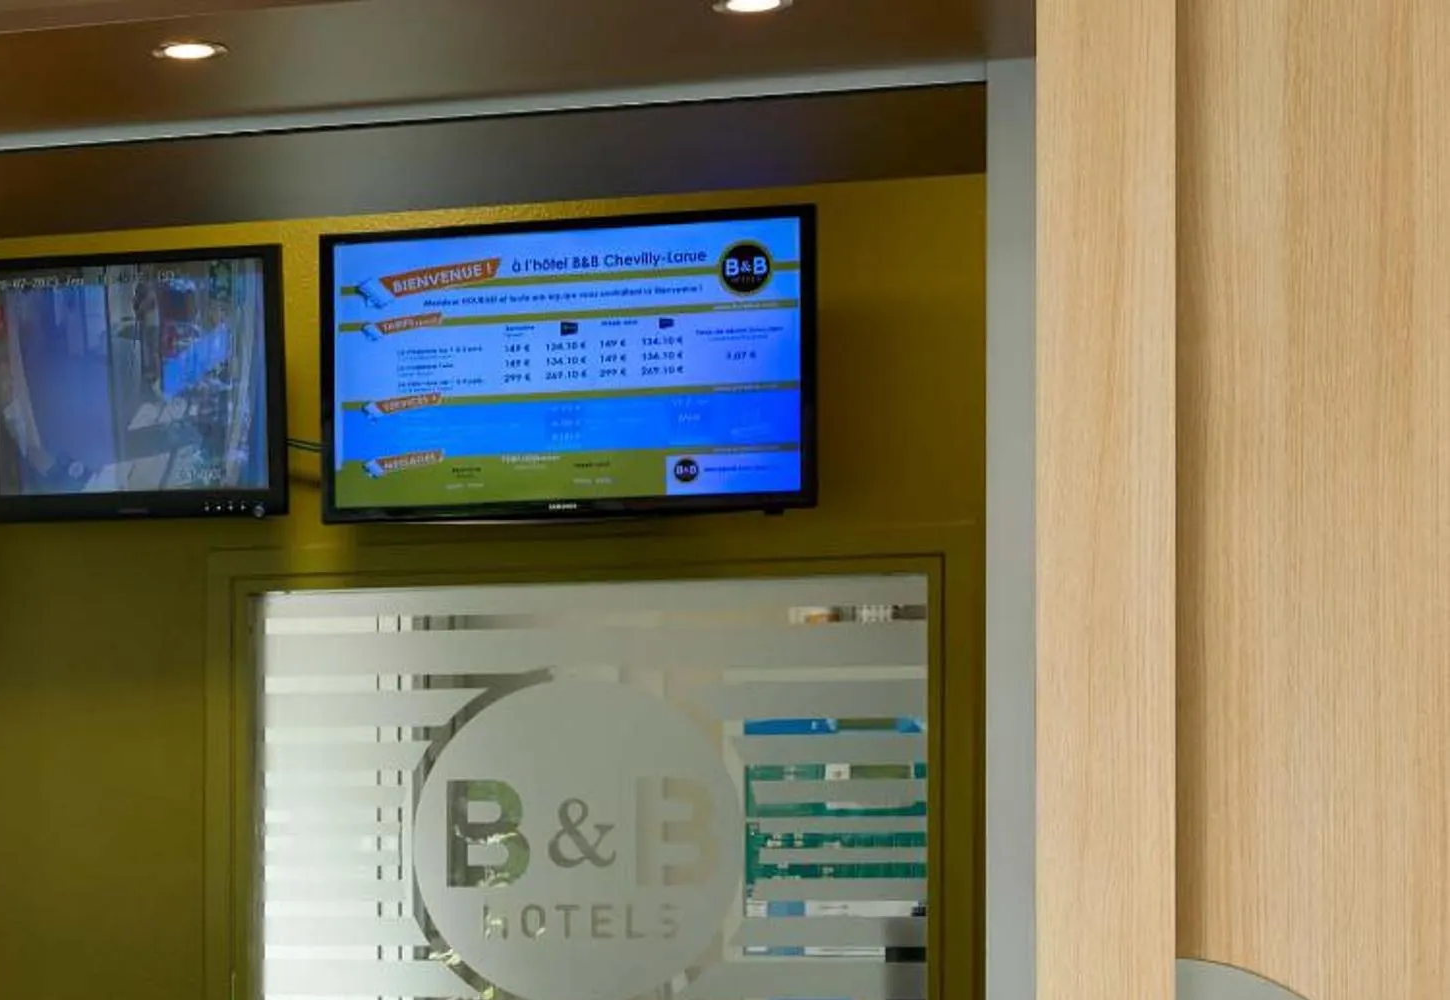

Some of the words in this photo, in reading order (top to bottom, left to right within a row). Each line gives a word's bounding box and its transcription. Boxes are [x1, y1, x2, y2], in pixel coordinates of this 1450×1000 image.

[512, 258, 521, 273] à
[525, 256, 568, 272] l'hôtel
[572, 255, 599, 269] B&B
[603, 250, 708, 269] Chevilly-Larue
[725, 256, 768, 276] B&B
[392, 264, 483, 293] BIENVENUE
[445, 776, 721, 888] B&B
[482, 902, 682, 941] HOTELS
